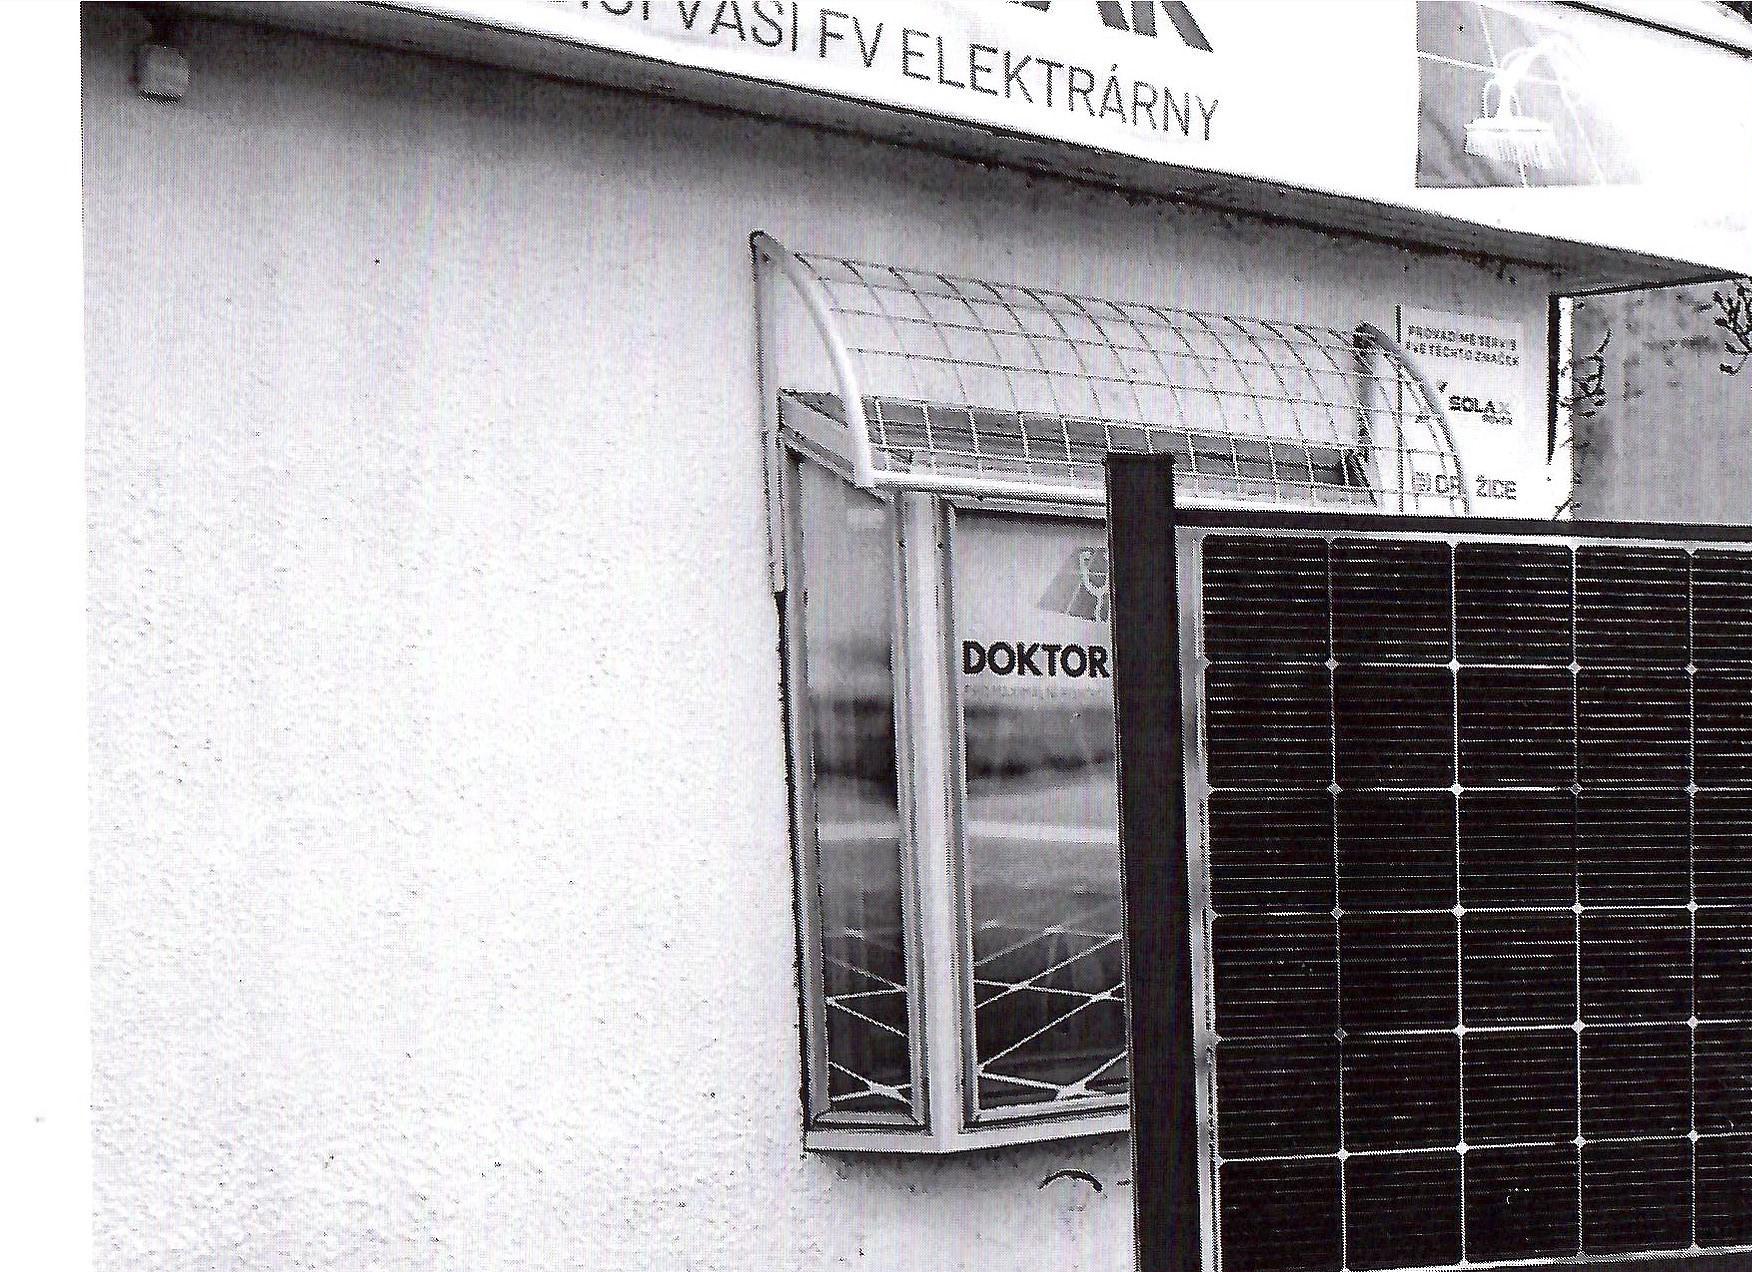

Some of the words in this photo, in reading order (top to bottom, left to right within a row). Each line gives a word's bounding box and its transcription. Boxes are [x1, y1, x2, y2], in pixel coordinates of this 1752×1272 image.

[820, 8, 884, 68] FV
[903, 27, 1218, 141] ELEKTRÁRNY
[1448, 395, 1511, 416] SOLAX
[962, 640, 1111, 678] DOKTOR
